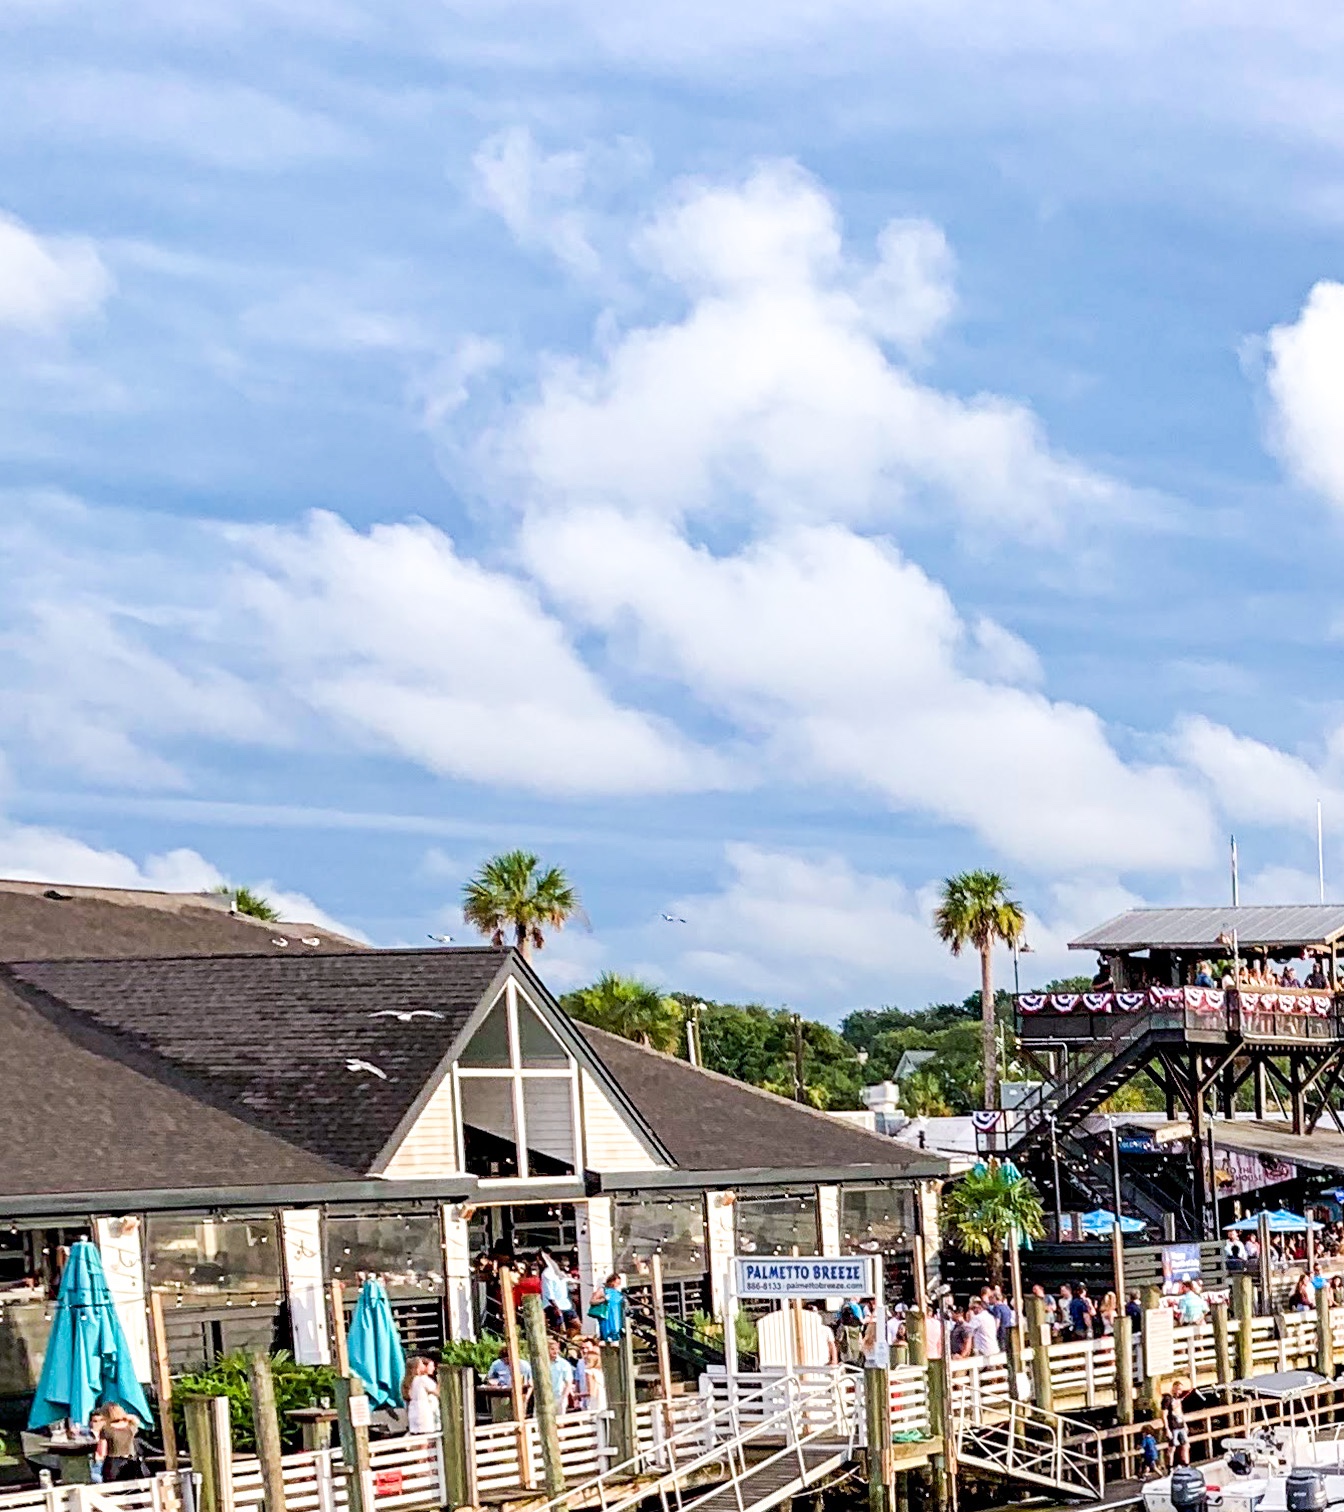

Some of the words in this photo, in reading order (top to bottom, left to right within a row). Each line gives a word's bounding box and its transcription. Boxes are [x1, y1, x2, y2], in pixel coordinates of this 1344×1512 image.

[746, 1265, 810, 1280] PALMETTO
[812, 1264, 860, 1280] BREEZE
[786, 1281, 863, 1291] palmettobreeze.com
